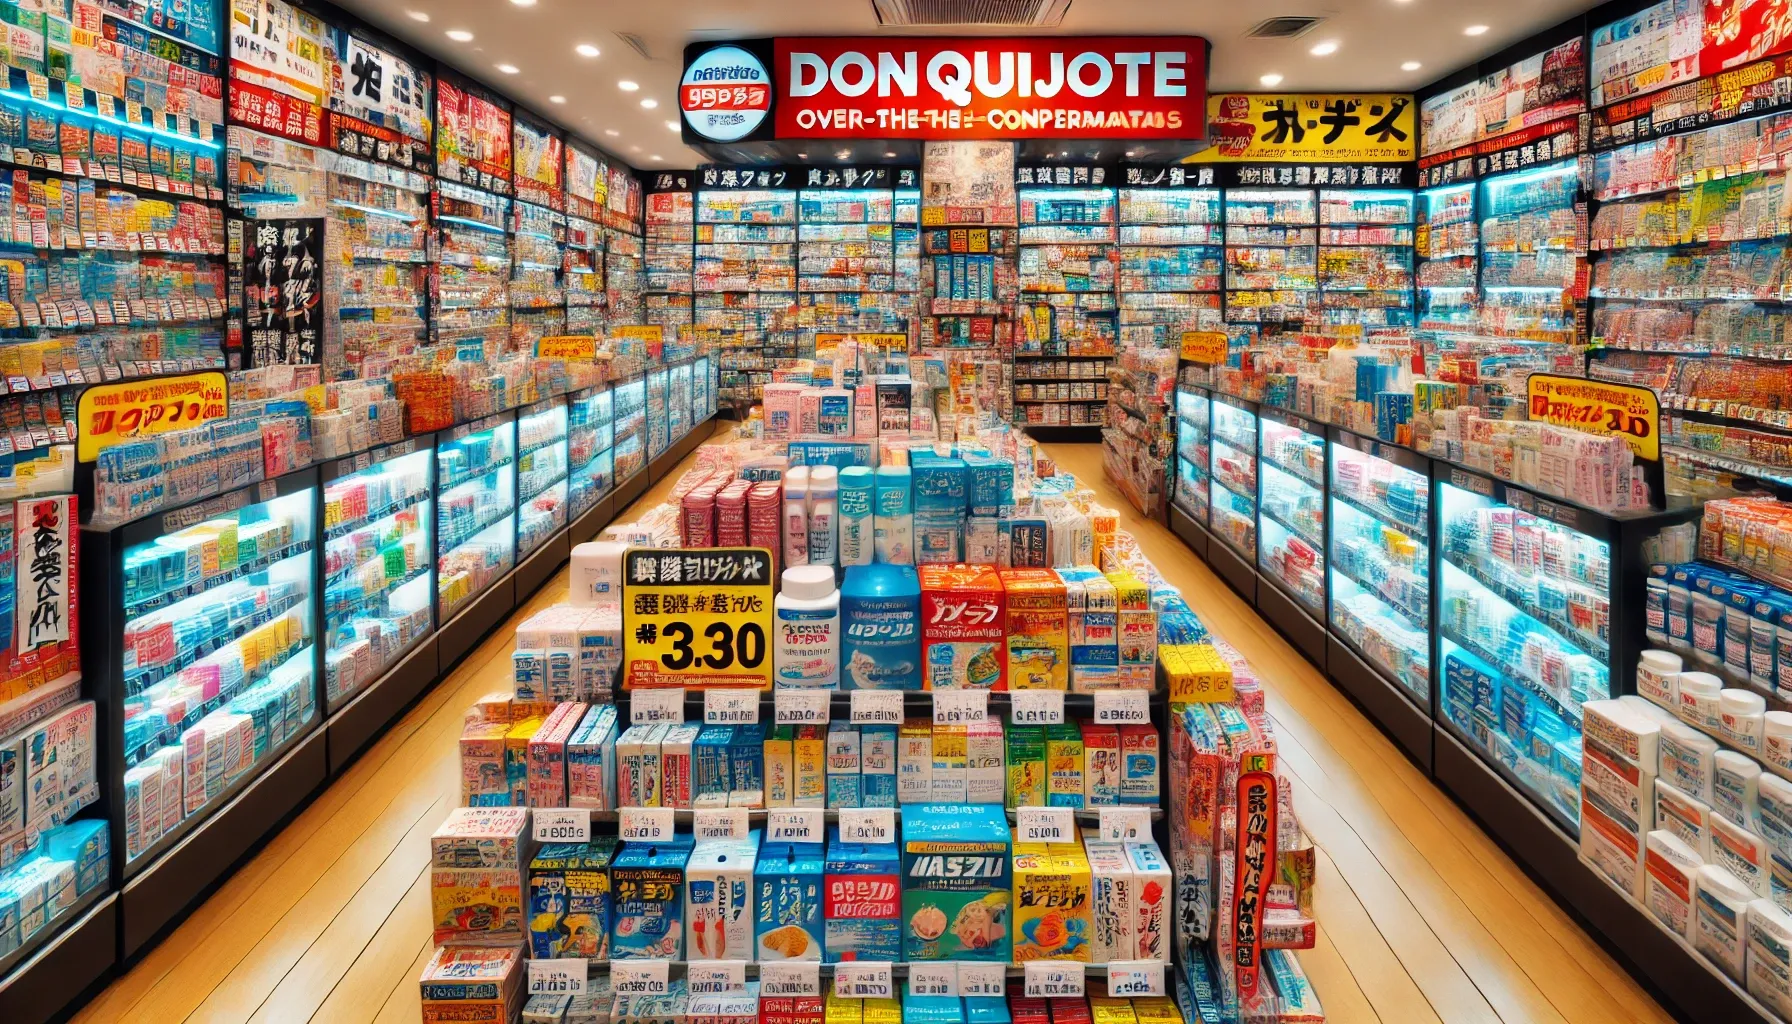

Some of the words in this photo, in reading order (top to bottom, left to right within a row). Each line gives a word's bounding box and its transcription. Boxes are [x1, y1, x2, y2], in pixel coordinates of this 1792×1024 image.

[789, 51, 918, 98] DON
[926, 51, 1187, 107] QUIJOTE
[661, 621, 766, 670] 3.30
